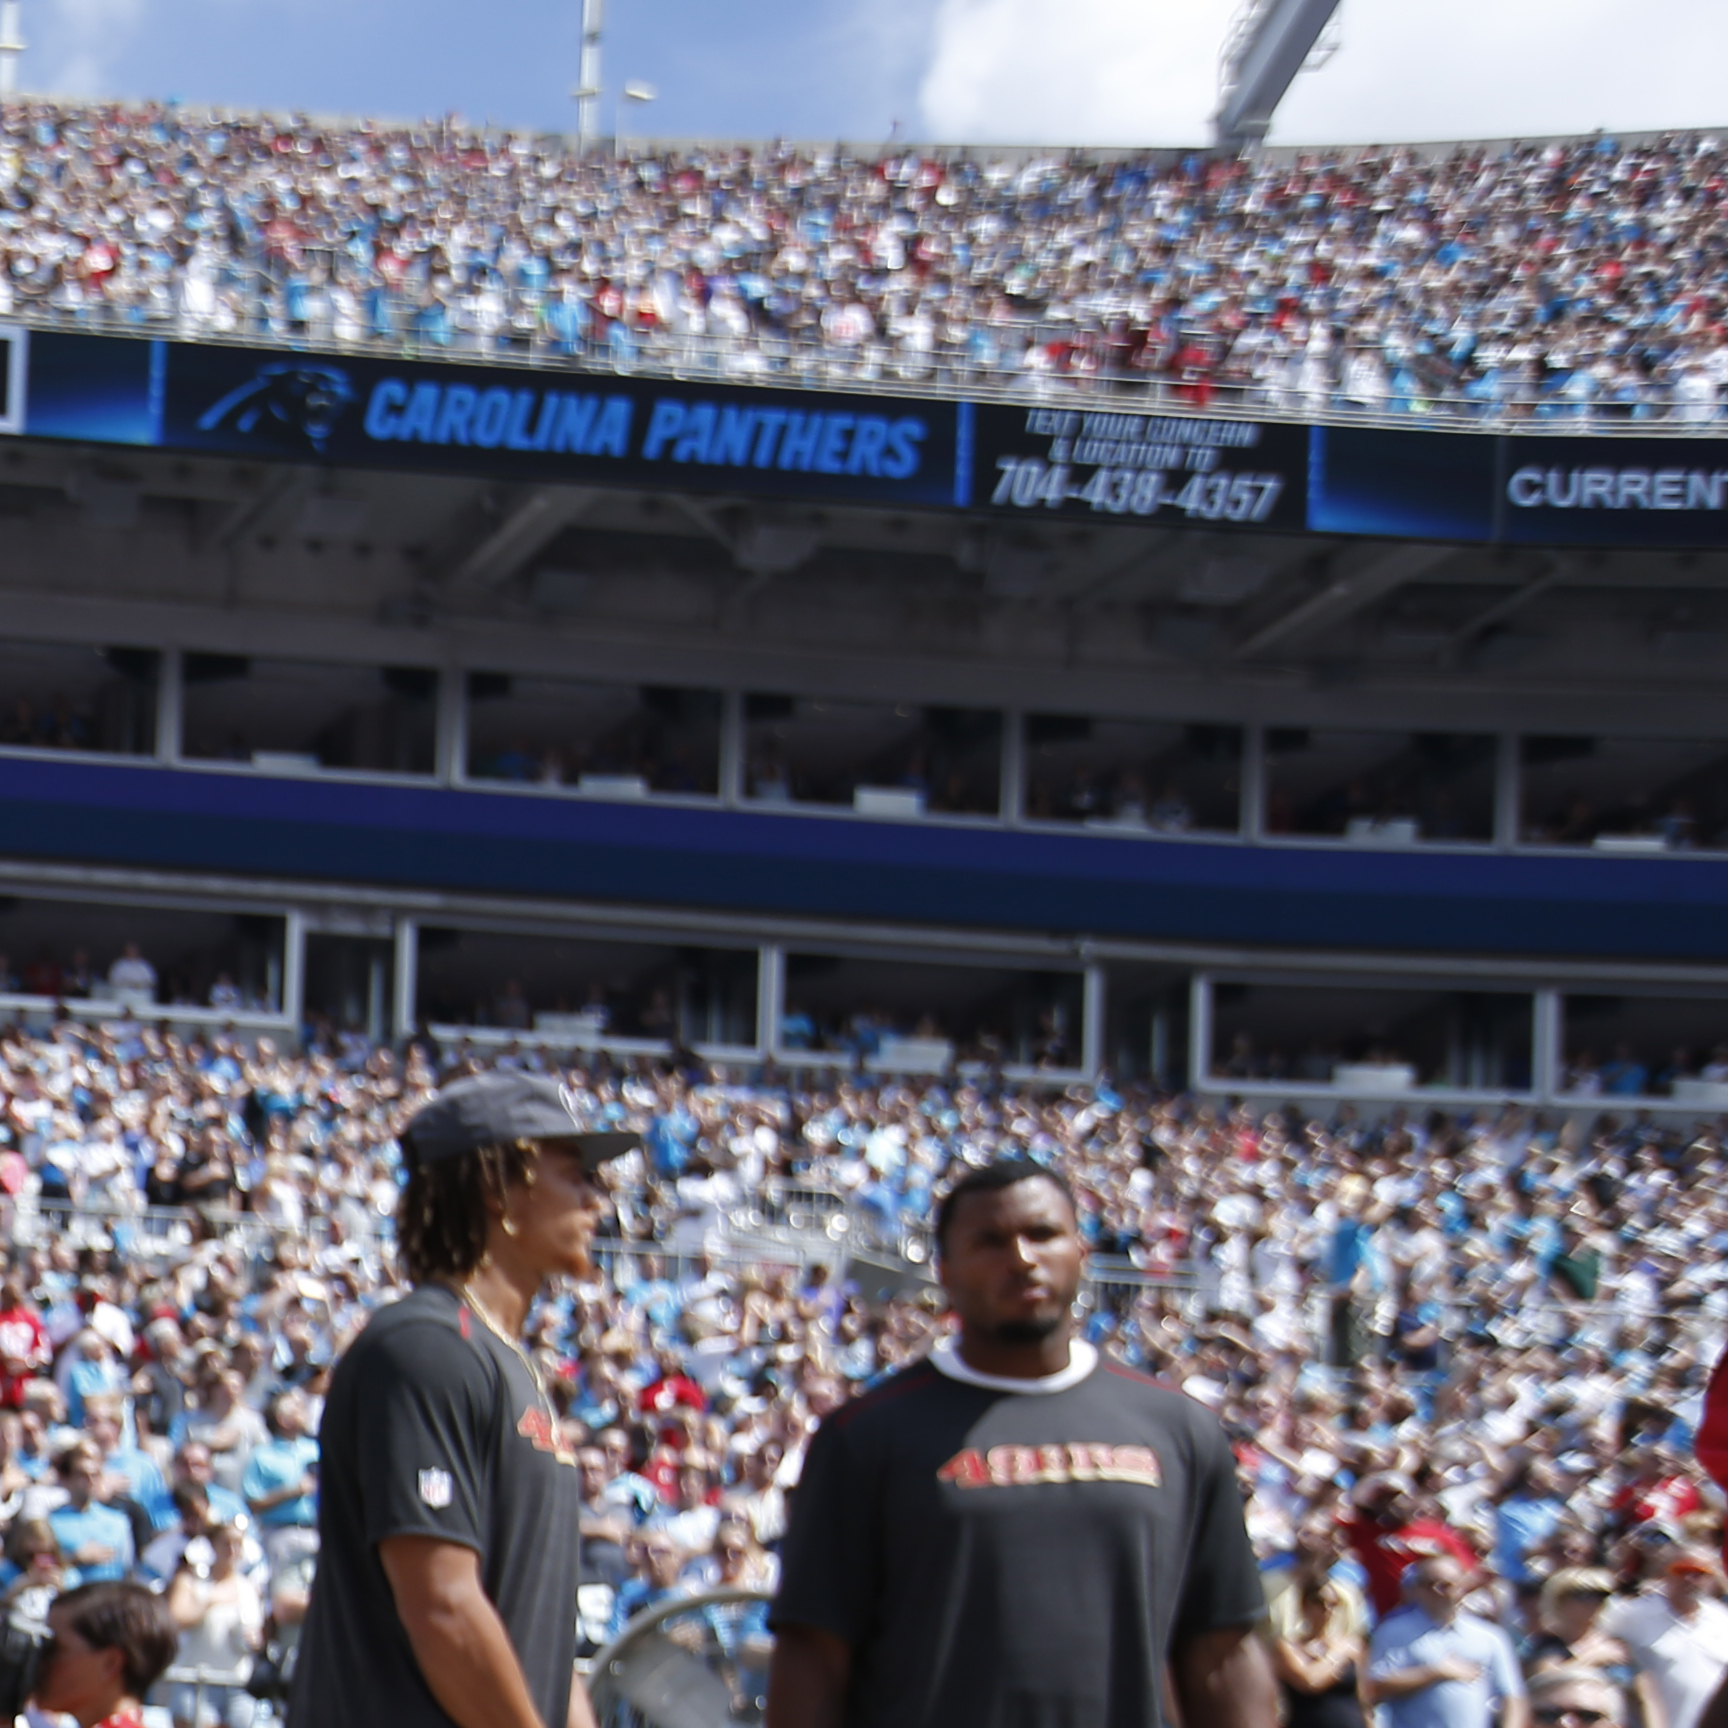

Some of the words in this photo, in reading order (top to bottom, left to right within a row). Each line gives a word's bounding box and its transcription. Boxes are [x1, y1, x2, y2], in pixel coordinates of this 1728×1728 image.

[363, 376, 634, 456] CAROLINA
[642, 399, 928, 480] PANTHERS
[991, 454, 1286, 522] 704-438-4357
